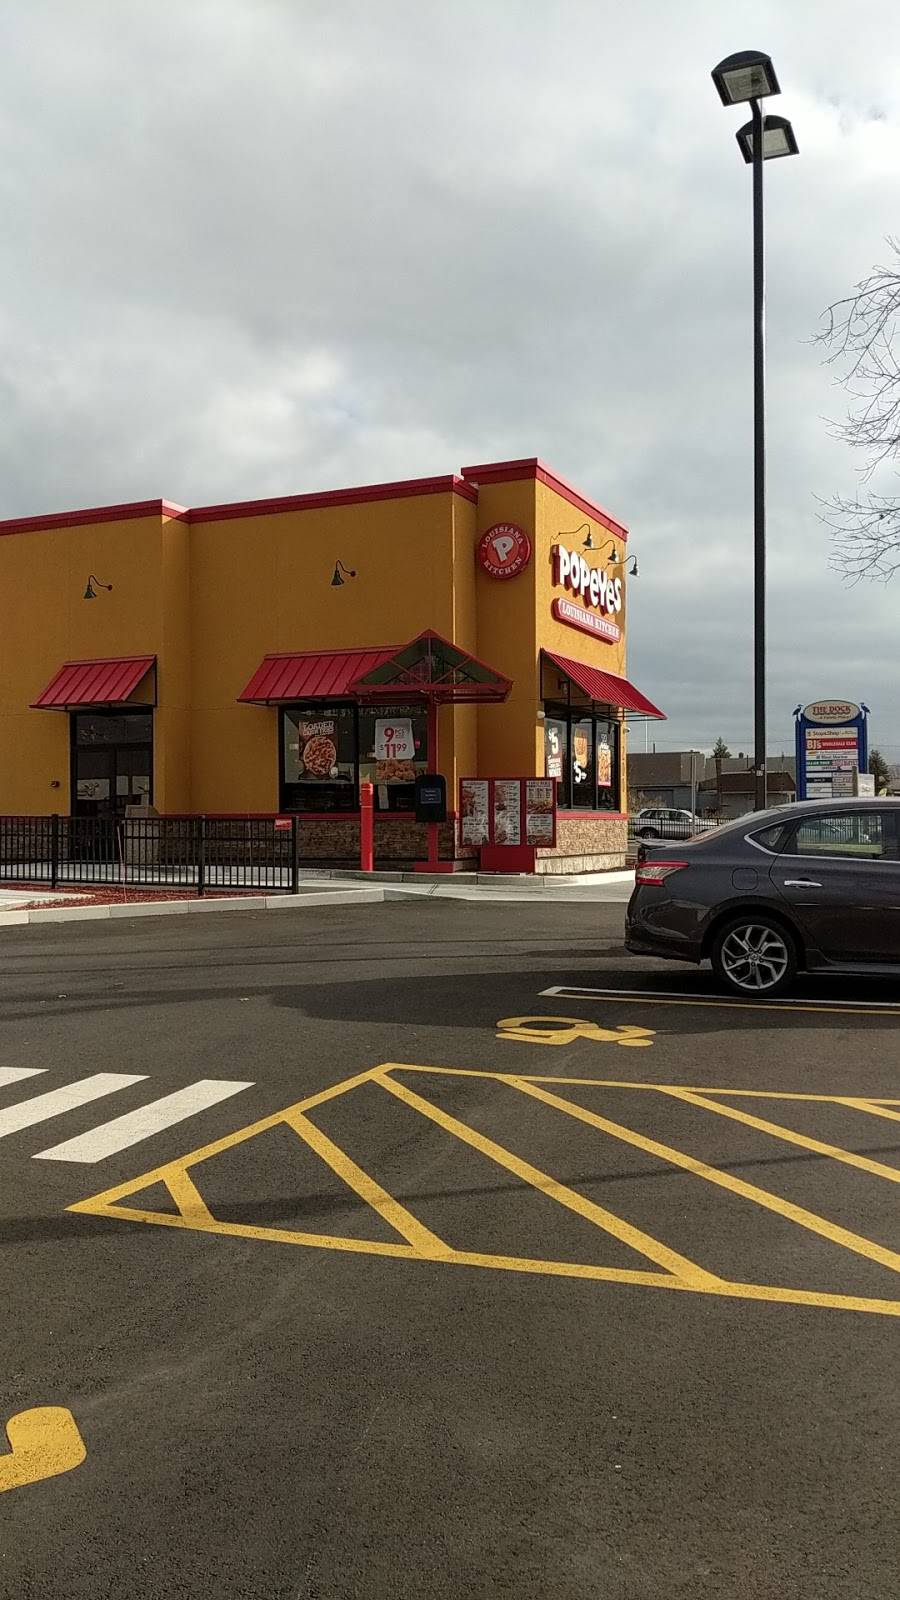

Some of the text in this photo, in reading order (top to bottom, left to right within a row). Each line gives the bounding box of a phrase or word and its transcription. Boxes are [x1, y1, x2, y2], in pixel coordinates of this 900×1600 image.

[482, 526, 523, 548] LOUISIANA
[492, 536, 514, 563] P
[483, 557, 523, 575] KITCHEN
[561, 602, 619, 637] LOUISIANA KITCHEN
[813, 705, 851, 714] THE DOCK
[384, 727, 394, 743] 9
